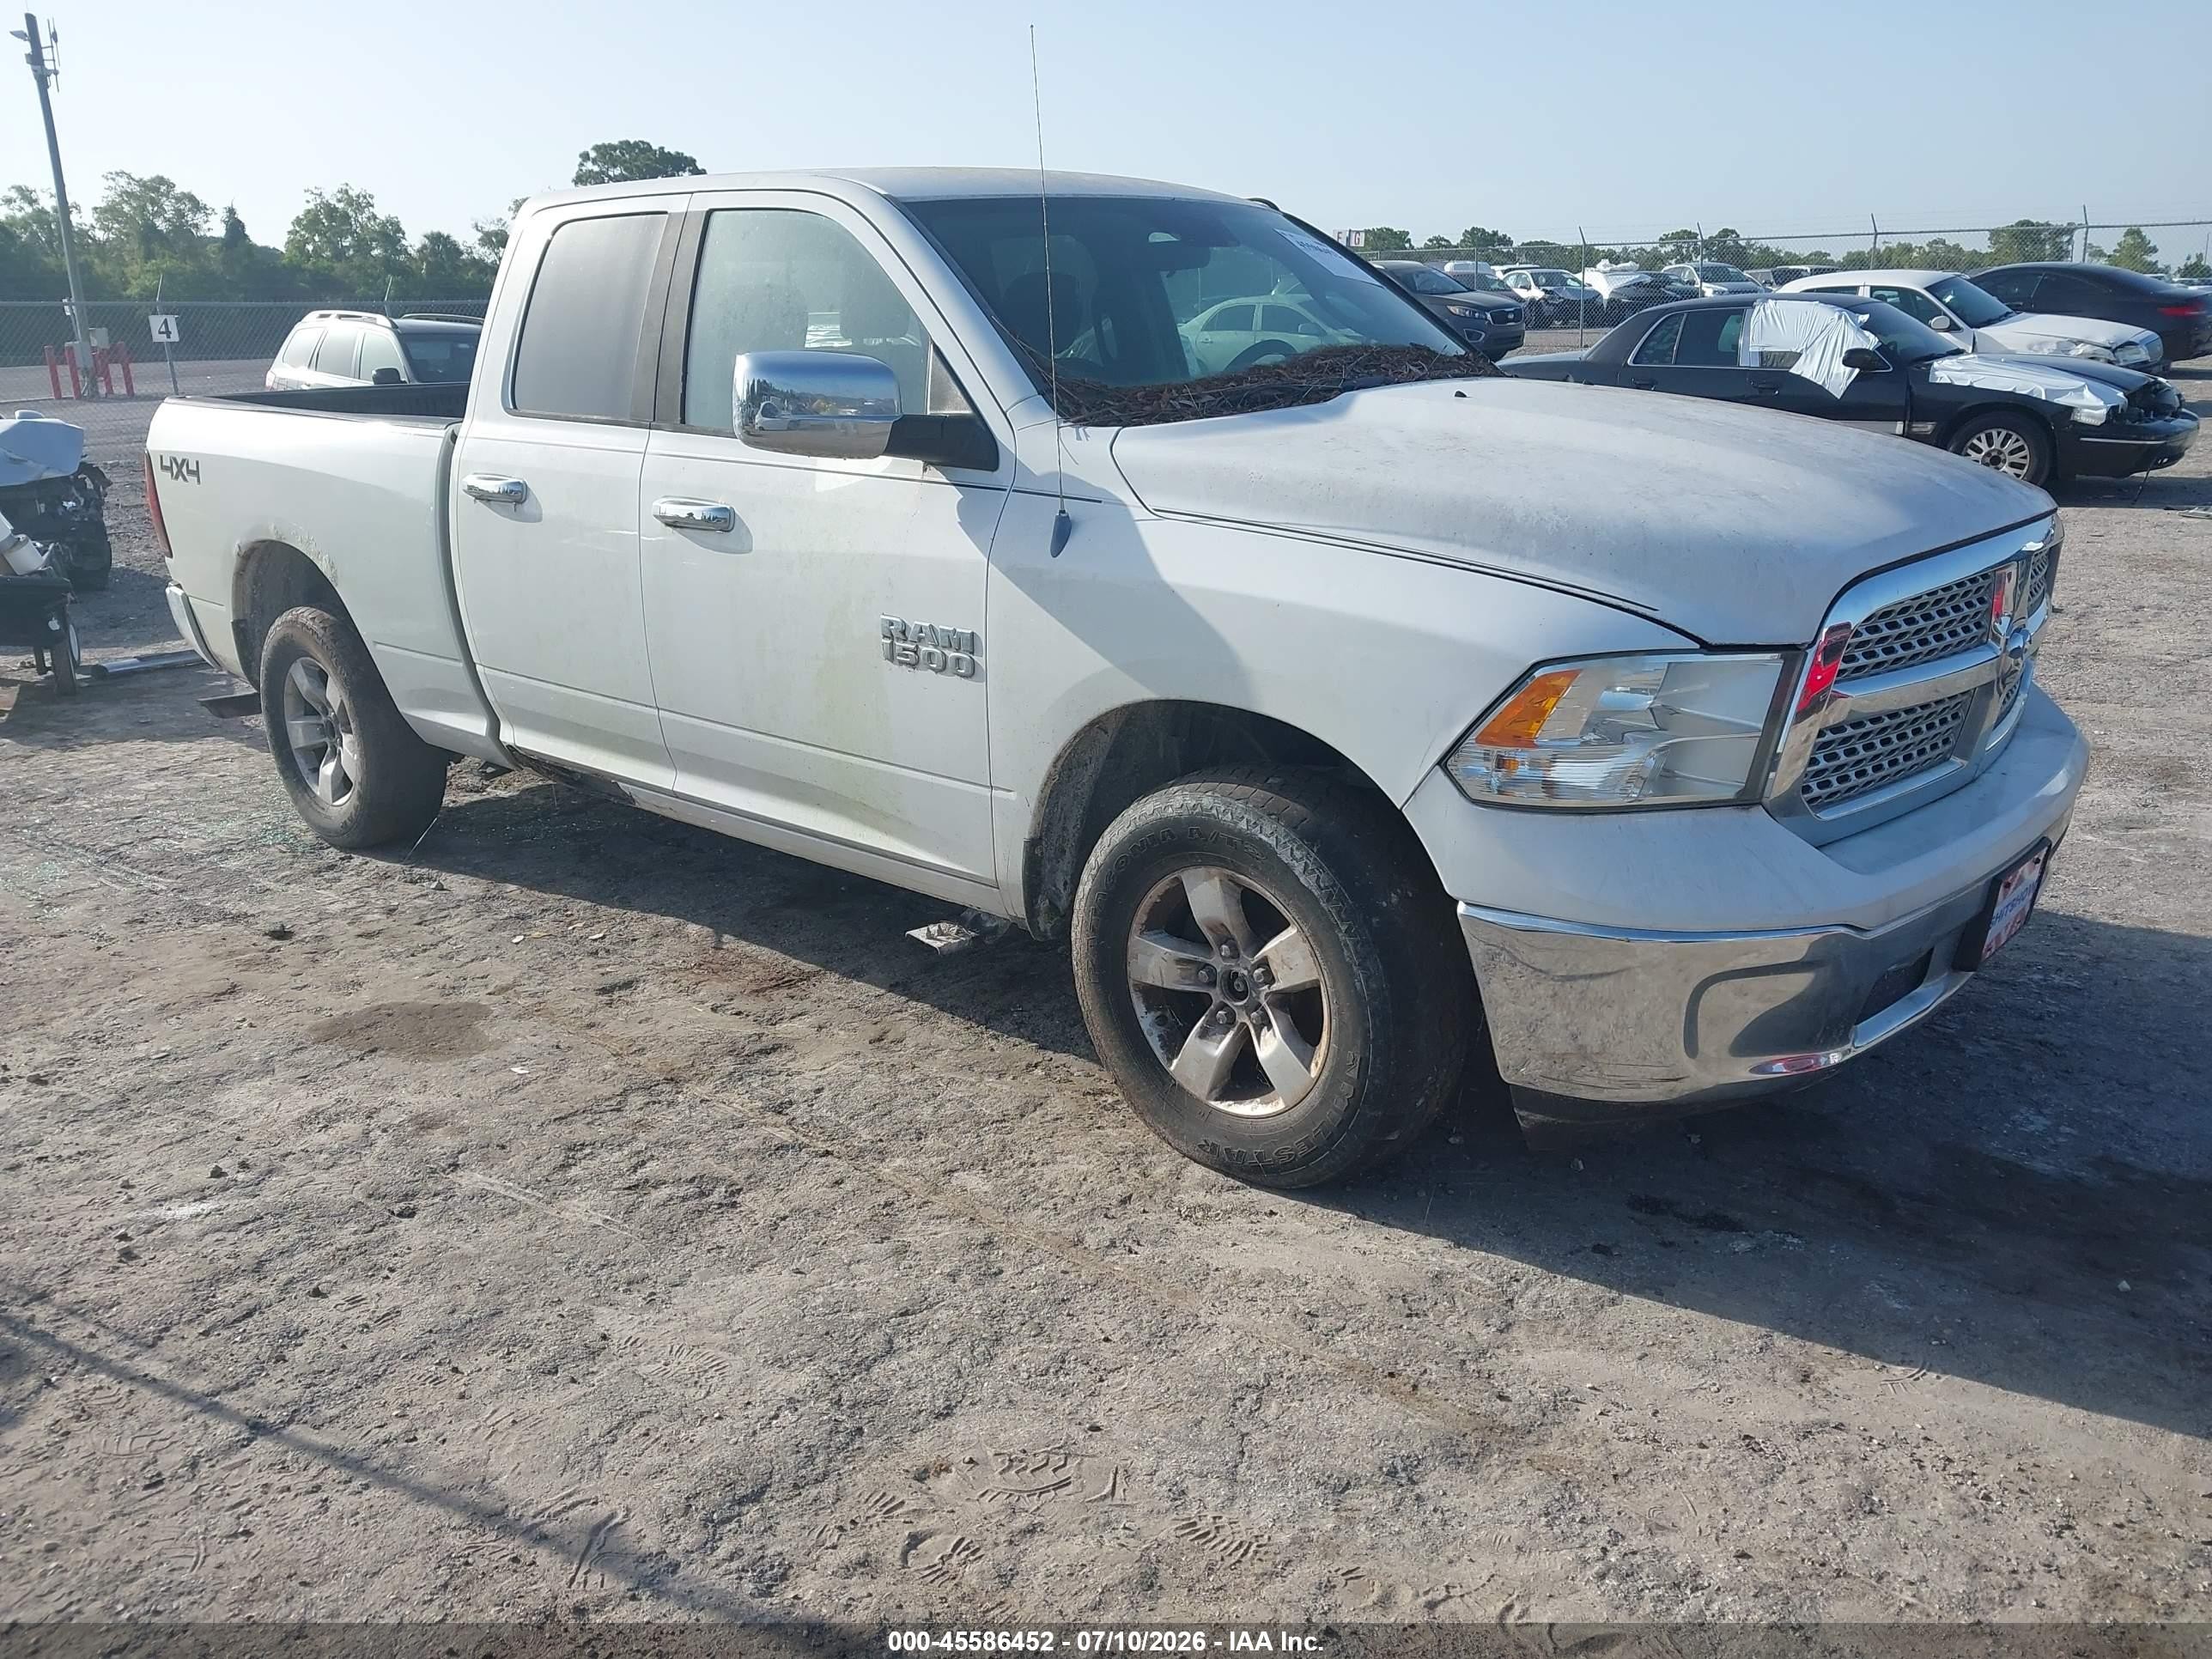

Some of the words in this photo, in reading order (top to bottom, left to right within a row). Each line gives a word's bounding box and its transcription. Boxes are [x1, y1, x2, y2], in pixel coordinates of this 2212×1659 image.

[1354, 231, 1361, 246] G
[158, 318, 172, 339] 4
[880, 613, 975, 655] RAM
[881, 638, 975, 678] 1500
